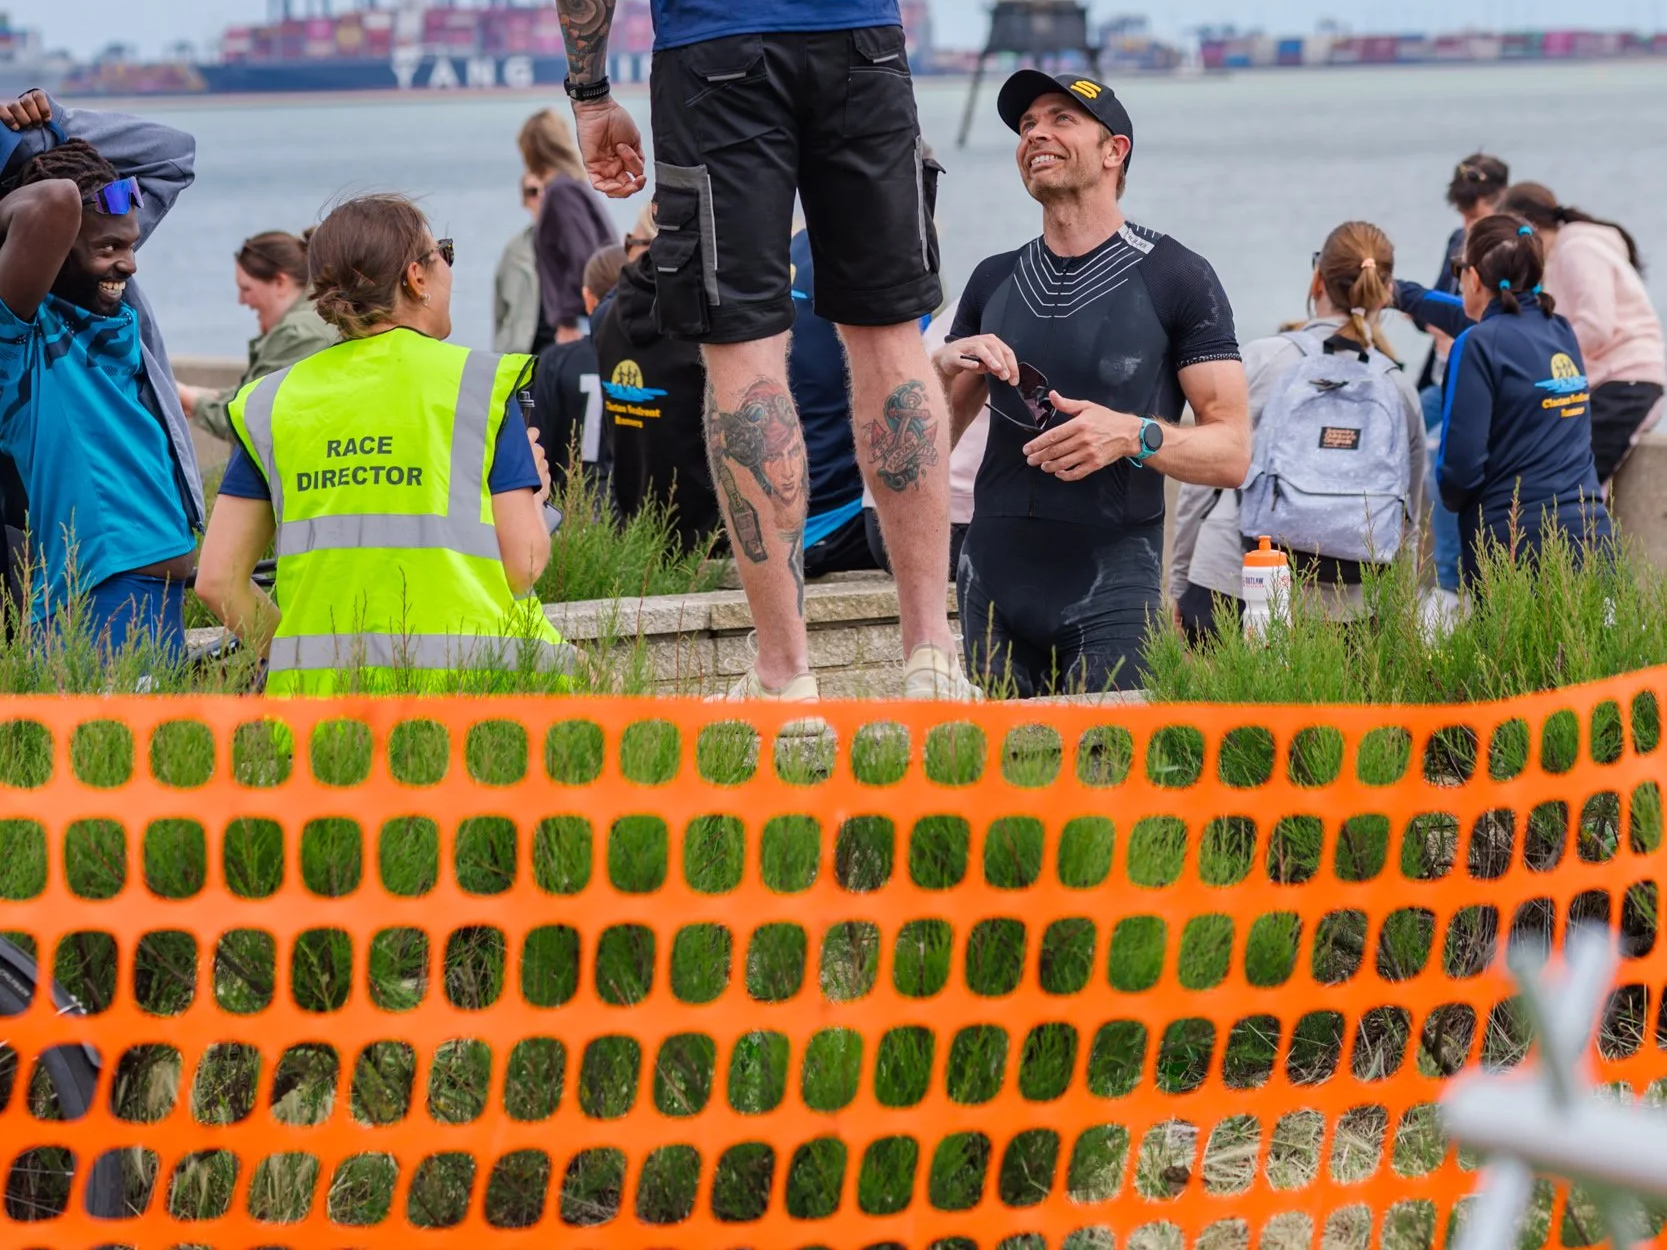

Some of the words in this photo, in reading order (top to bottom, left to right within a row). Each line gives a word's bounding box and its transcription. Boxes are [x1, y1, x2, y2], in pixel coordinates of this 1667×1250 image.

[392, 53, 534, 88] YANG
[326, 436, 393, 458] RACE
[296, 465, 423, 492] DIRECTOR
